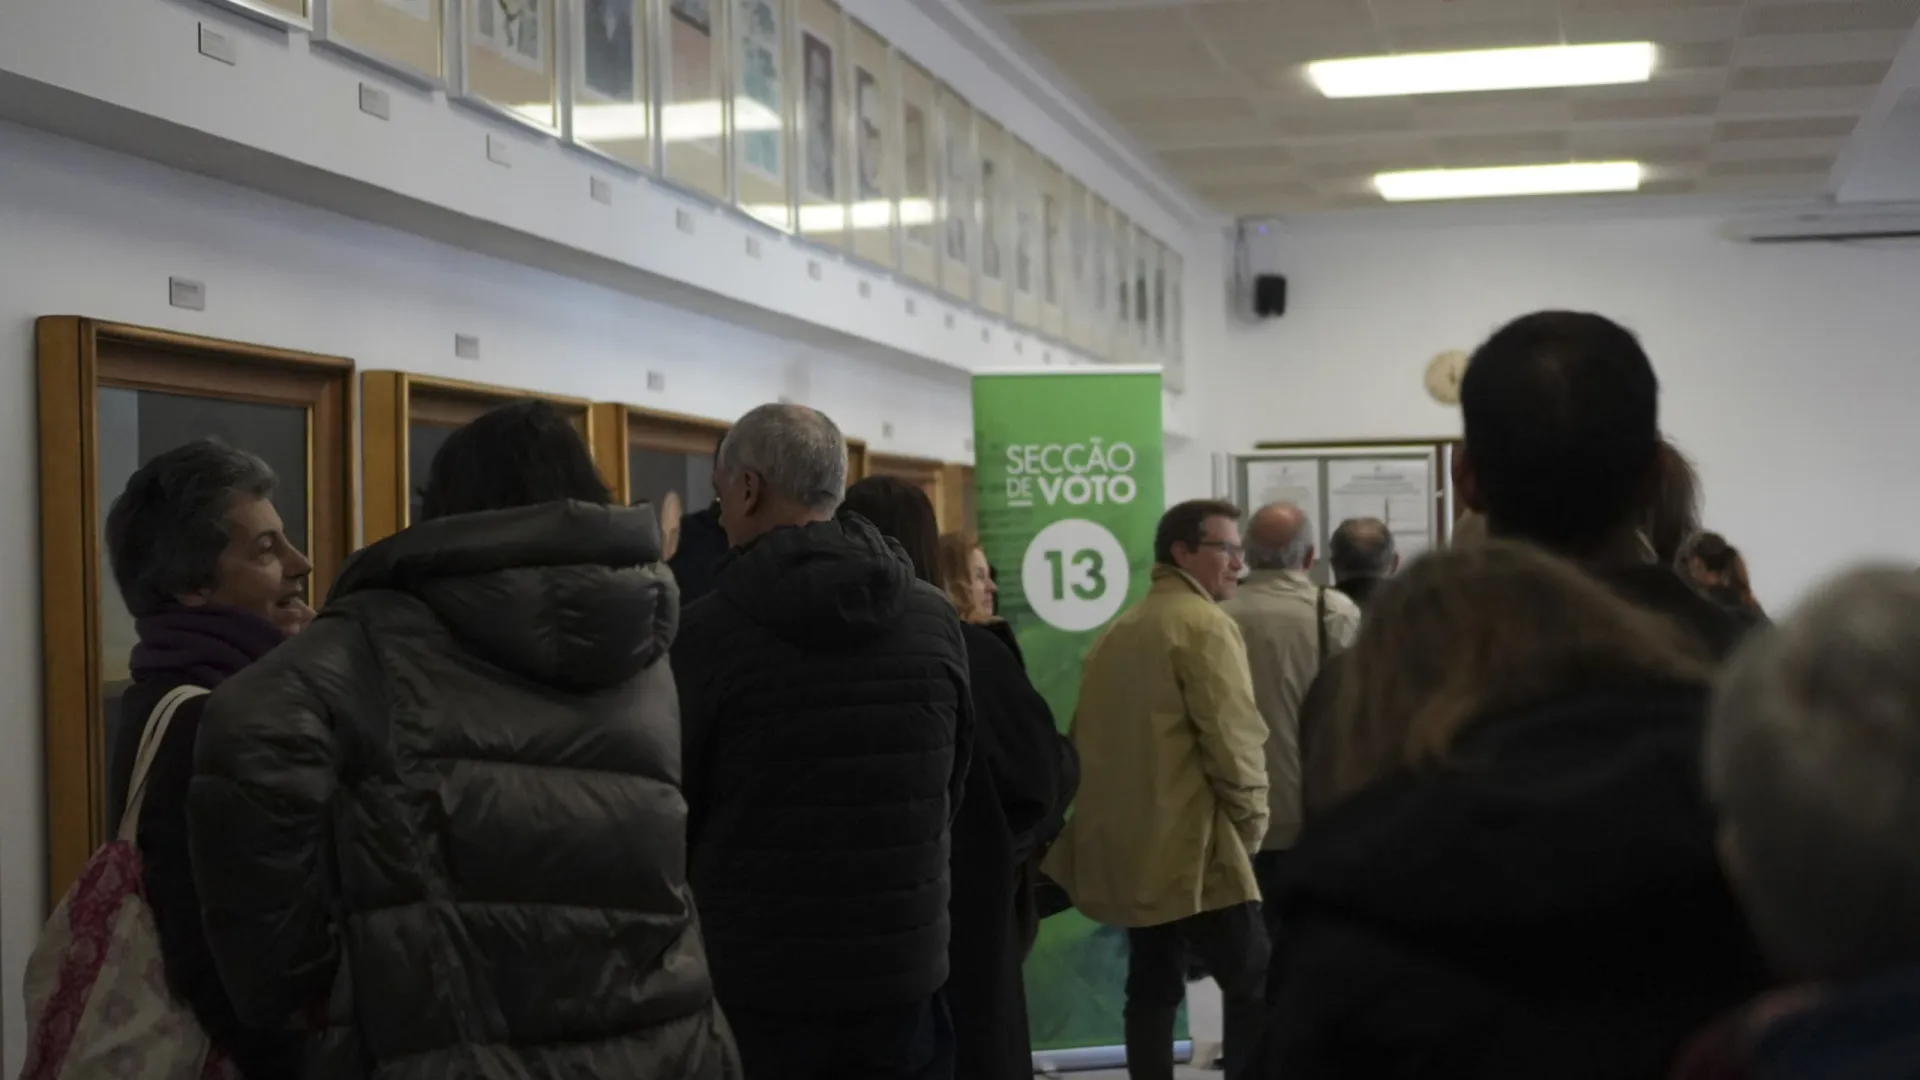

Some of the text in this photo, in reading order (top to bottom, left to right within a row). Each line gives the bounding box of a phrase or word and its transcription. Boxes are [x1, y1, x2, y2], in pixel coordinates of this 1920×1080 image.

[1006, 436, 1135, 475] SECÇÃO
[1006, 475, 1136, 505] DE VOTO
[1043, 548, 1107, 601] 13
